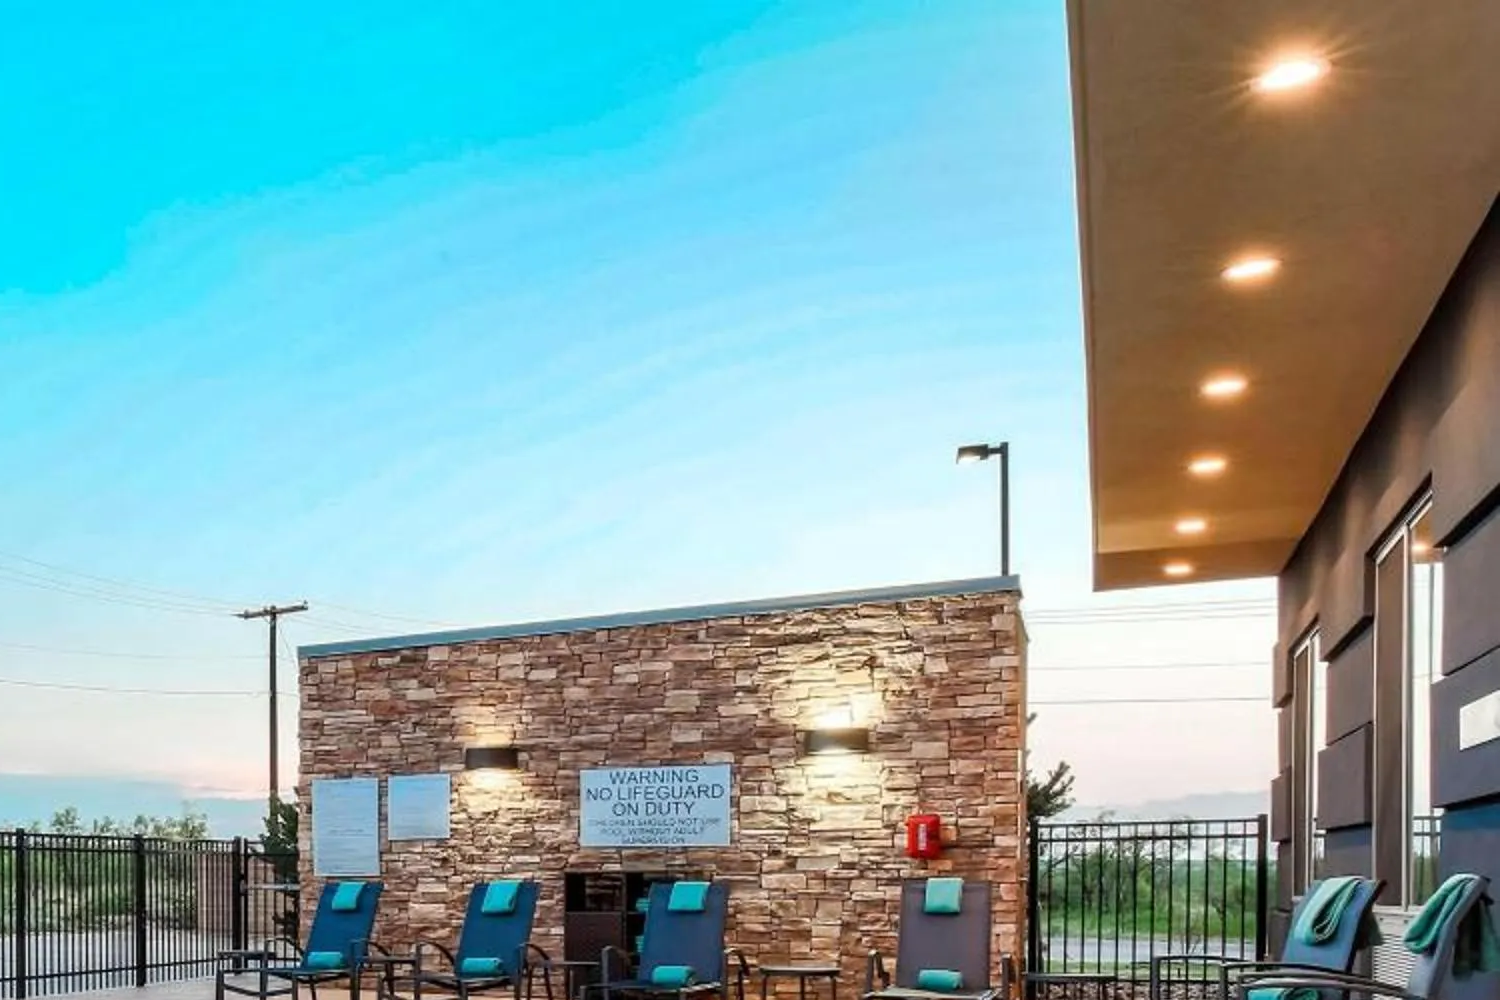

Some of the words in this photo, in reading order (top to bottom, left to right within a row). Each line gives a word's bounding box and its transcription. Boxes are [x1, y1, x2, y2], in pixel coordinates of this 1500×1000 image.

[609, 769, 699, 784] WARNING
[586, 787, 613, 801] NO
[617, 784, 725, 801] LIFEGUARD
[612, 802, 639, 816] ON
[645, 801, 695, 815] DUTY
